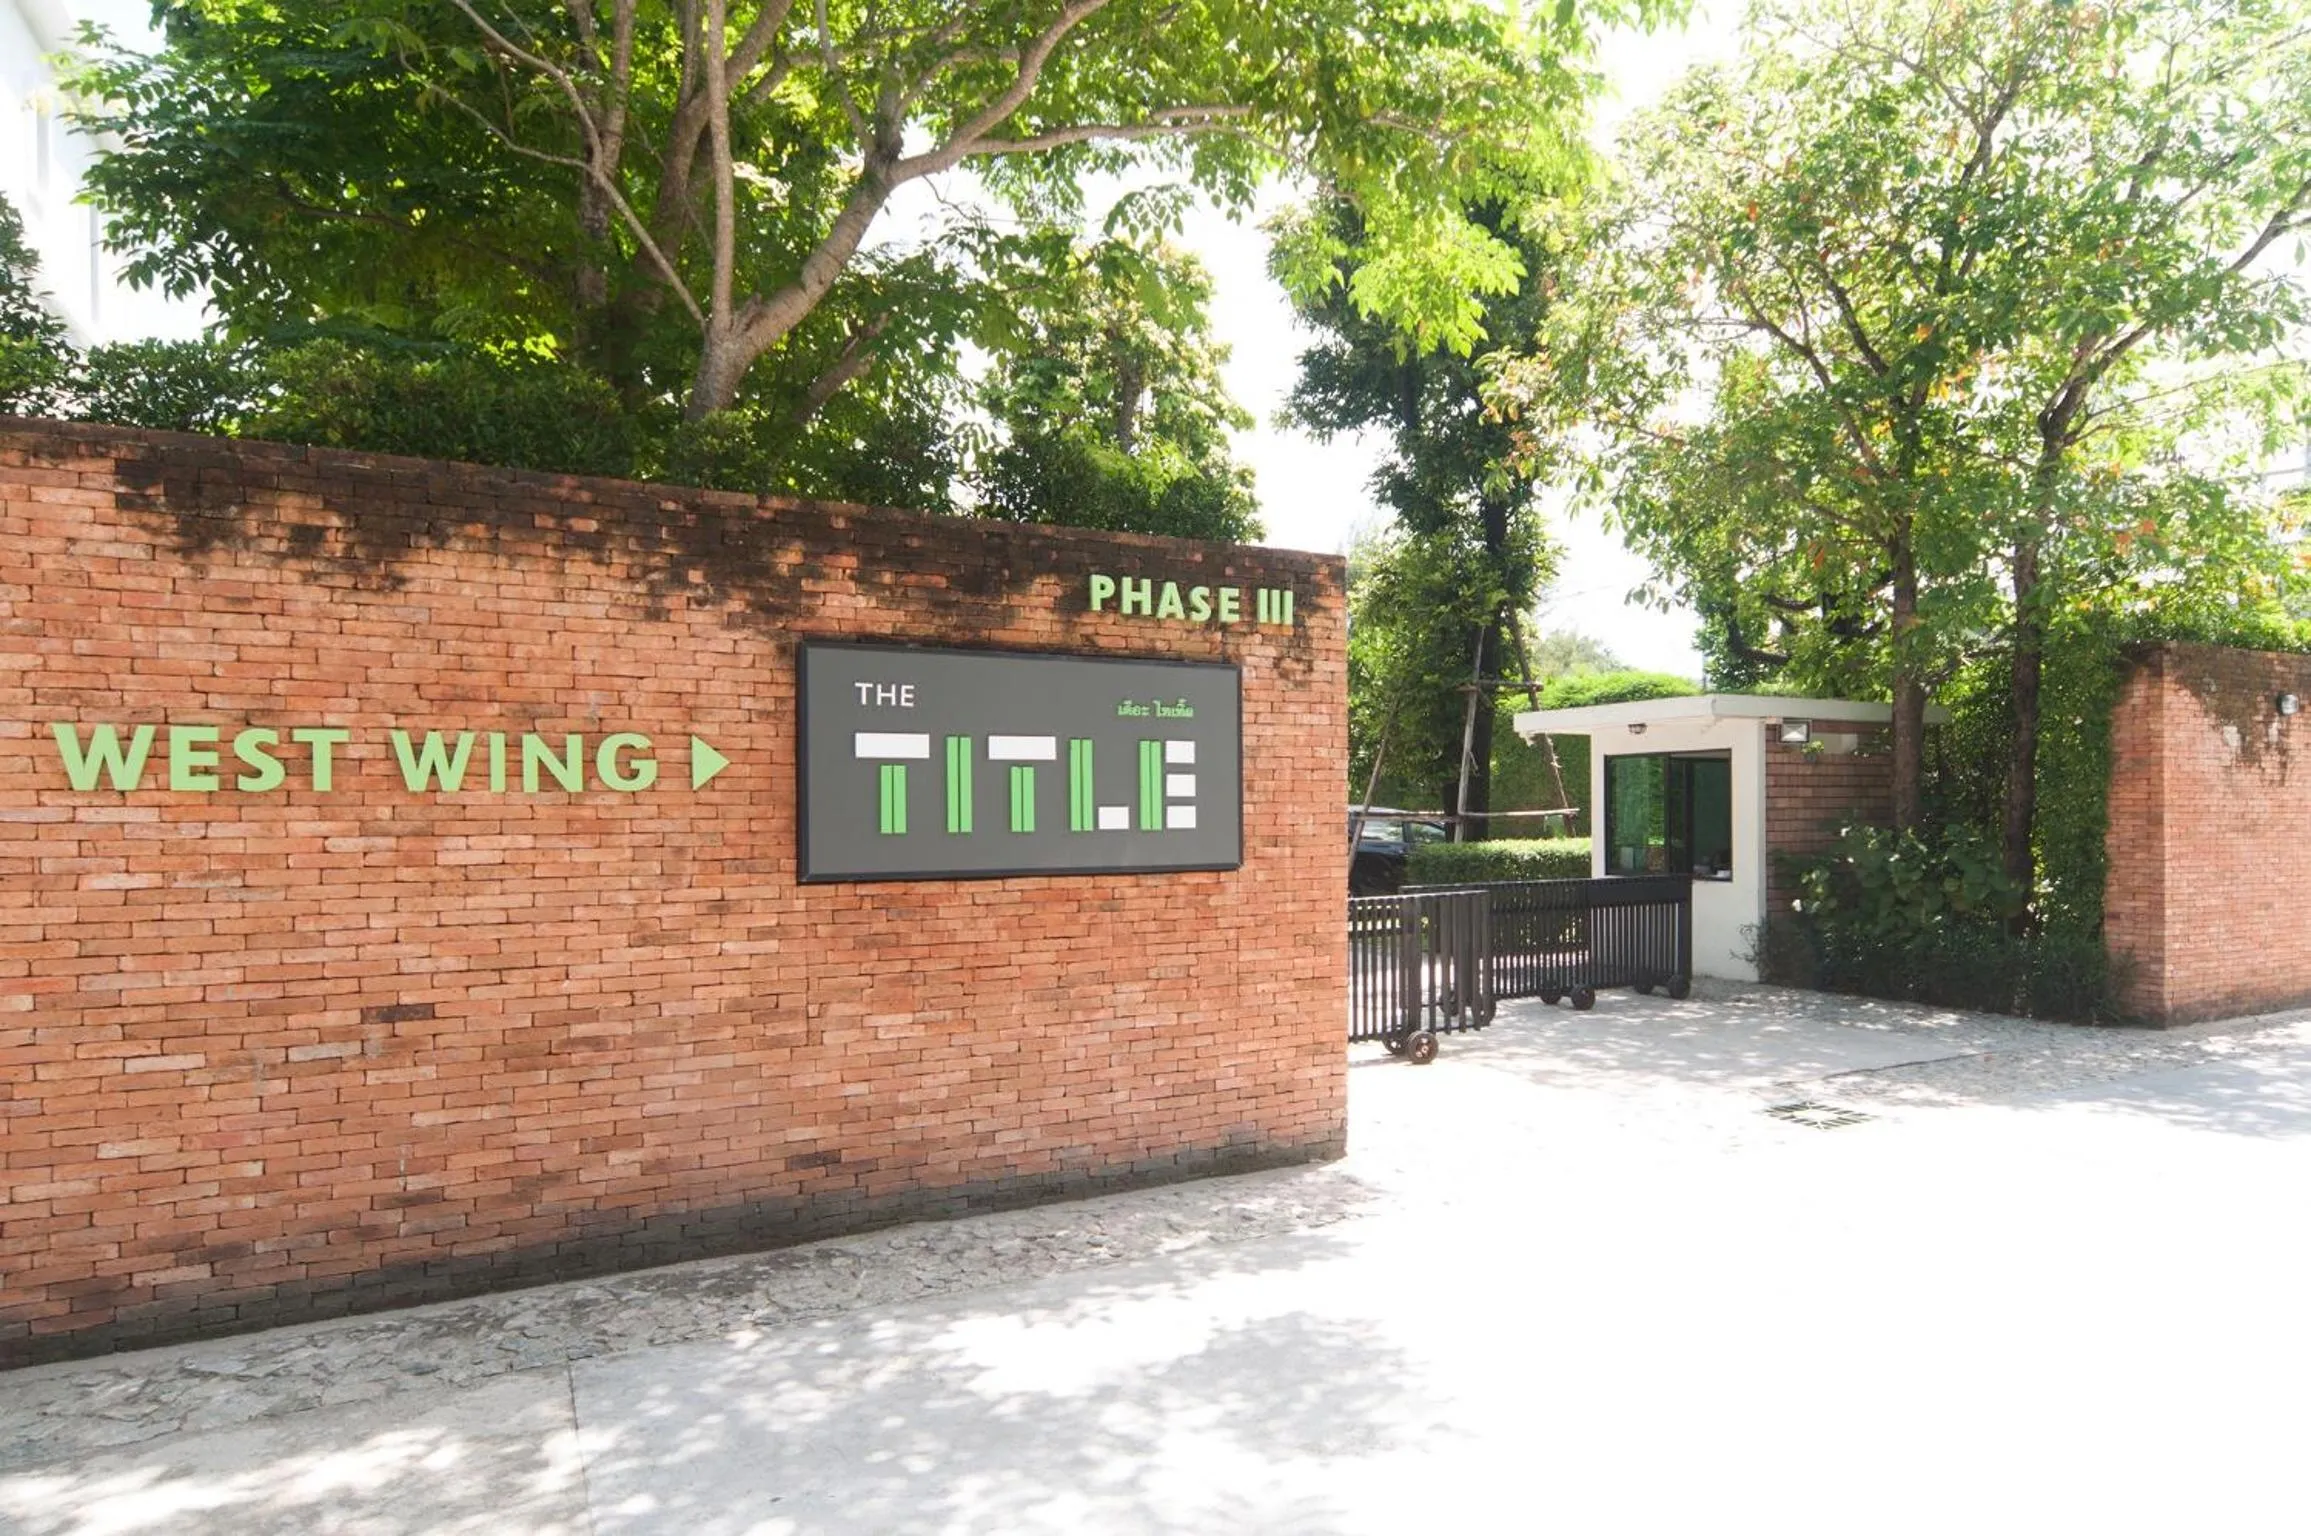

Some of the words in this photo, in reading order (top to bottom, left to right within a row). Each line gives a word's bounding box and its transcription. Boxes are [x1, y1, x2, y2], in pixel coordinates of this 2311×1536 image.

[1090, 574, 1240, 622] PHASE
[1257, 588, 1293, 625] III
[855, 682, 914, 706] THE
[52, 723, 349, 793] WEST
[390, 731, 658, 794] WING
[855, 732, 1196, 834] TITLE
